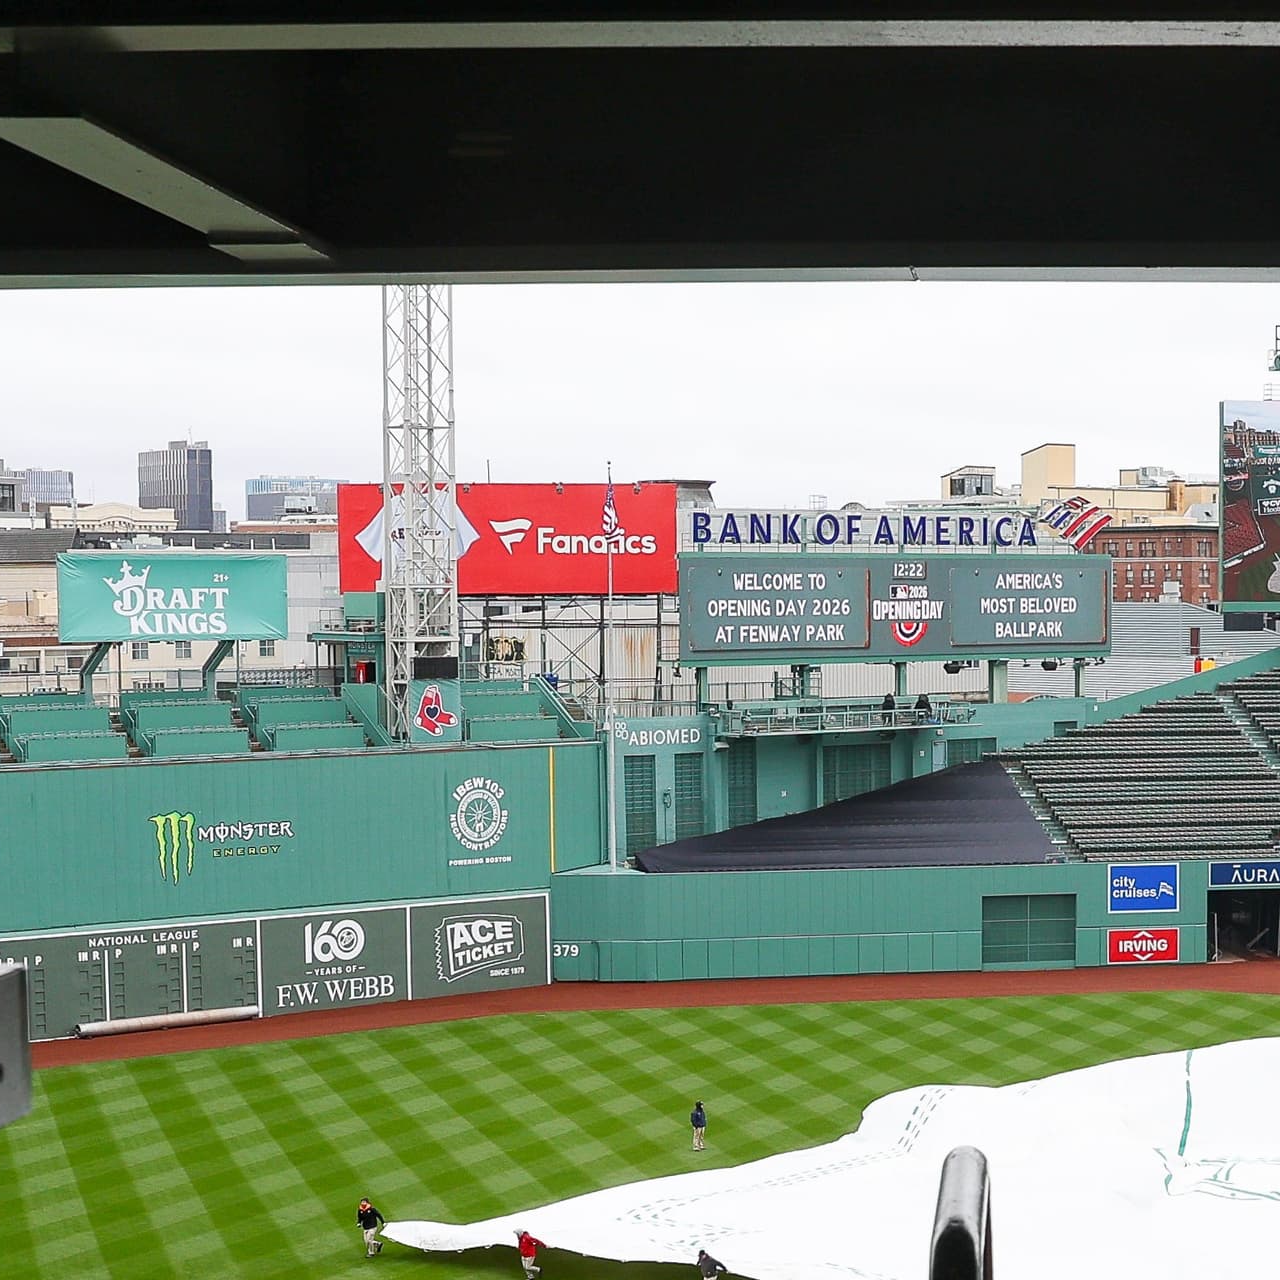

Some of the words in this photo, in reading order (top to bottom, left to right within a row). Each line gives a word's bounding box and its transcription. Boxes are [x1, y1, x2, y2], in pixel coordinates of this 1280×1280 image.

[692, 512, 803, 544] BANK
[815, 513, 862, 545] OF
[873, 515, 1038, 546] AMERICA
[213, 573, 229, 583] 21+
[893, 563, 923, 577] 12:22
[733, 573, 798, 591] WELCOME
[807, 574, 826, 590] TO
[995, 573, 1064, 590] AMERICA'S
[113, 585, 229, 616] DRAFT
[909, 585, 928, 598] 2026
[707, 599, 771, 617] OPENING
[775, 599, 807, 617] DAY
[812, 599, 851, 616] 2026
[980, 598, 1016, 615] MOST
[1020, 598, 1077, 615] BELOVED
[130, 610, 228, 635] KINGS
[995, 622, 1063, 639] BALLPARK
[715, 626, 736, 643] AT
[739, 625, 800, 643] FENWAY
[805, 624, 845, 642] PARK
[629, 728, 700, 746] ABIOMED
[452, 777, 484, 801] IBEW
[485, 779, 504, 799] 103
[198, 821, 294, 843] MONSTER
[461, 810, 508, 851] CONTRACTORS
[213, 845, 281, 857] ENERGY
[449, 857, 484, 867] POWERING
[485, 855, 512, 864] BOSTON
[1113, 876, 1136, 888] city
[1113, 887, 1157, 899] cruises
[88, 933, 148, 948] NATIONAL
[153, 930, 199, 943] LEAGUE
[304, 919, 365, 964] 160
[452, 919, 514, 949] ACE
[35, 955, 42, 966] P
[78, 951, 88, 961] IN
[92, 950, 100, 960] R
[115, 948, 122, 958] P
[156, 944, 166, 955] IN
[170, 943, 178, 953] R
[193, 941, 200, 951] P
[233, 938, 242, 947] IN
[246, 937, 253, 947] R
[455, 940, 515, 967] TICKET
[553, 944, 579, 957] 379
[1119, 939, 1168, 953] IRVING
[314, 966, 342, 976] YEARS
[345, 965, 357, 974] OF
[489, 968, 509, 978] SINCE
[277, 984, 319, 1009] F.W.
[324, 975, 395, 1001] WEBB
